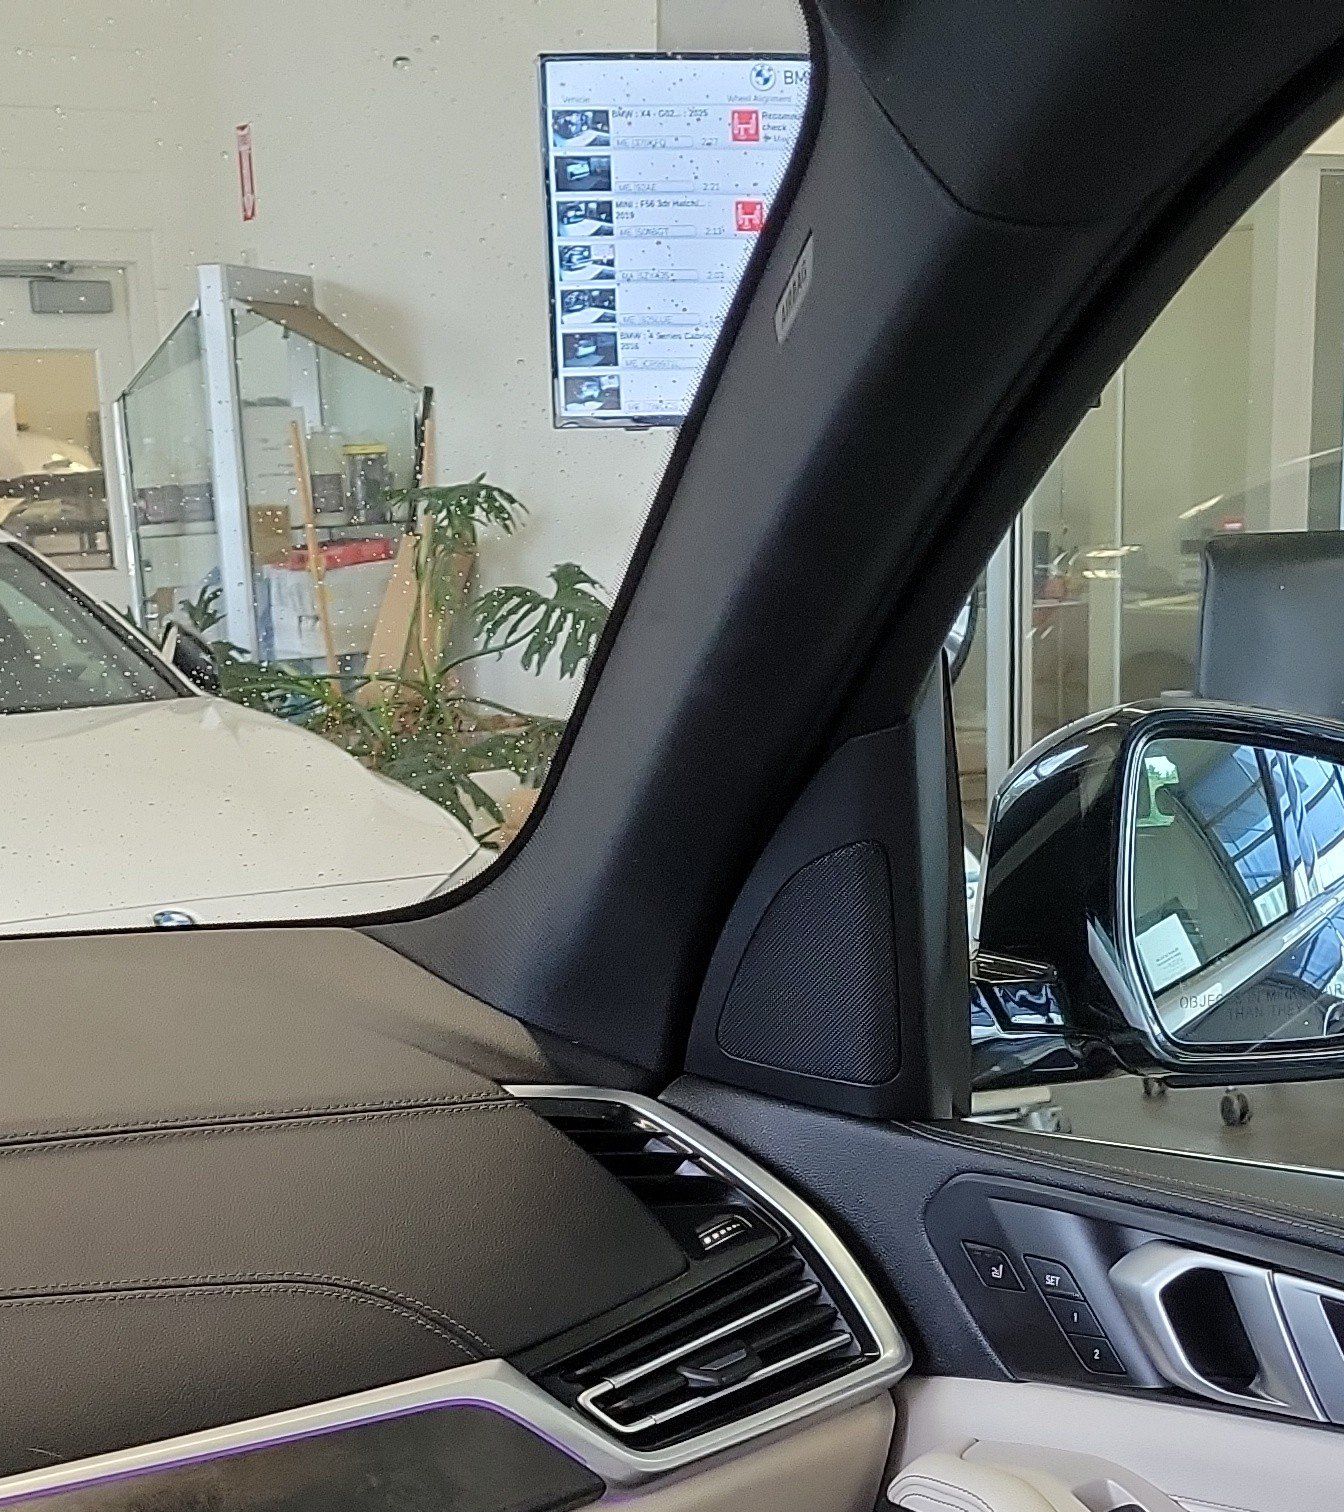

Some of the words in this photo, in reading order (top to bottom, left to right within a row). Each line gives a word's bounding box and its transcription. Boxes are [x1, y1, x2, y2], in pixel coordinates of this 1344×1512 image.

[1045, 1274, 1061, 1287] SET
[1073, 1312, 1078, 1323] 1
[1093, 1348, 1101, 1360] 2
